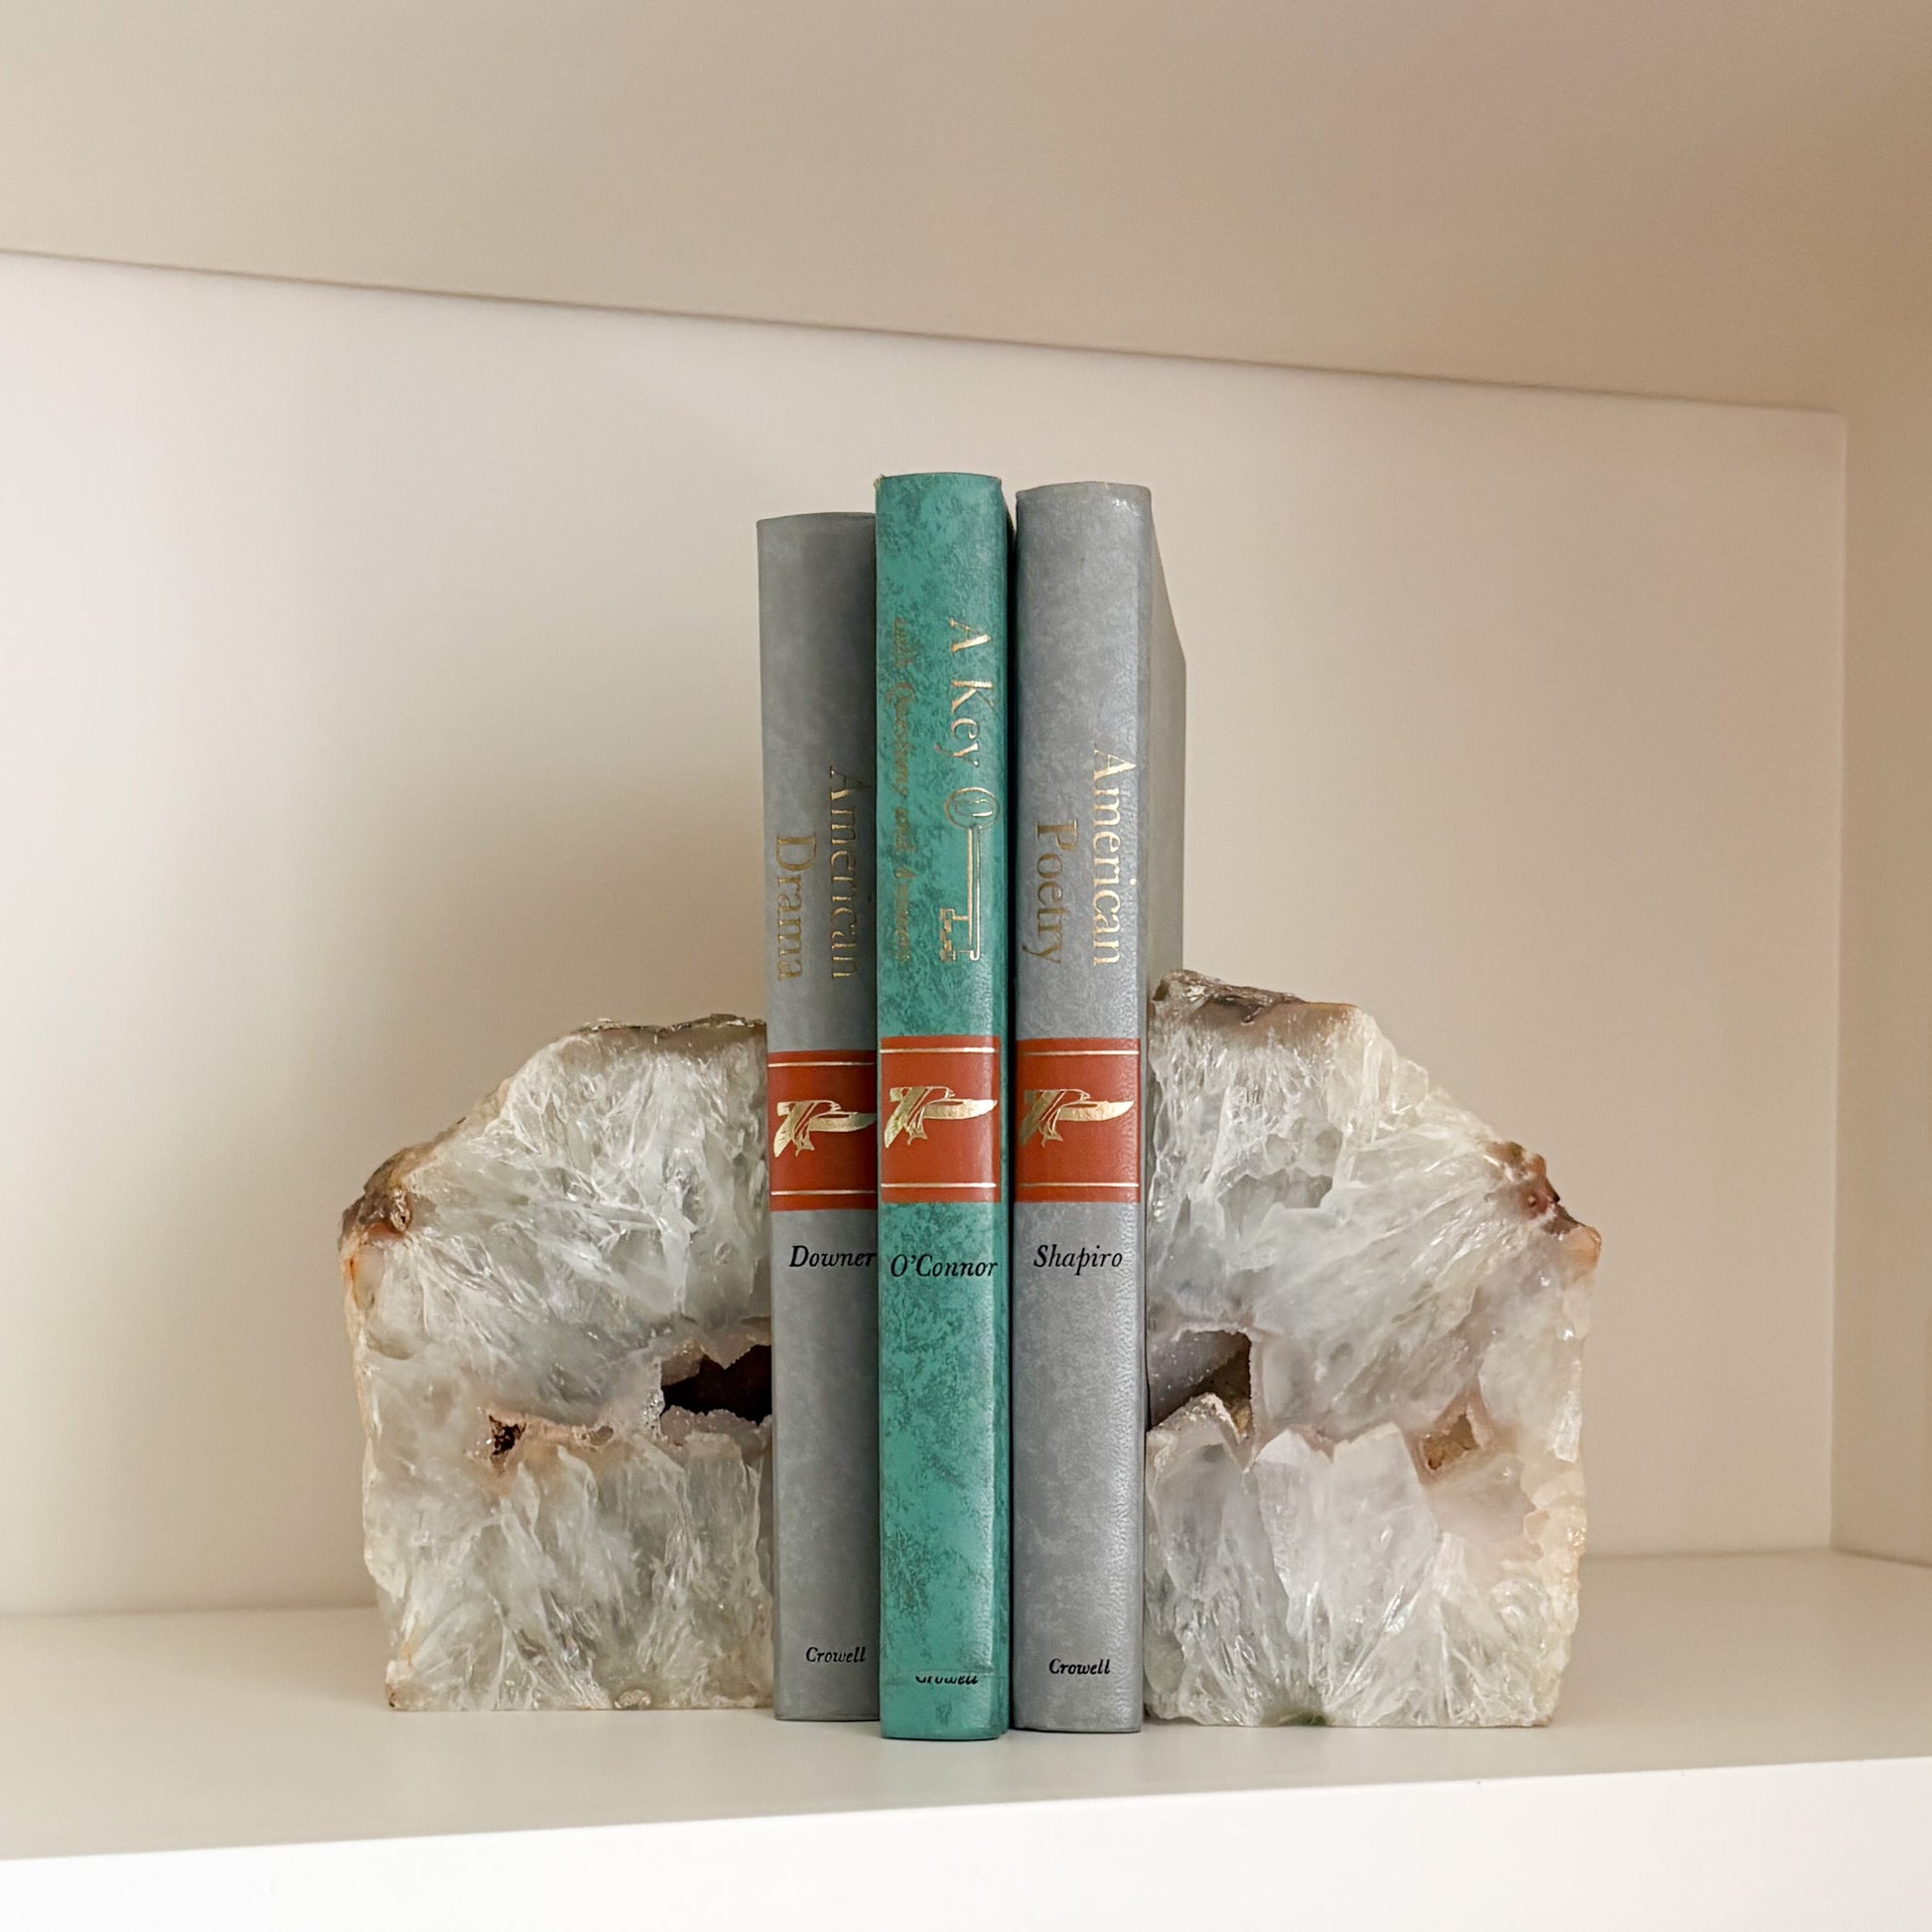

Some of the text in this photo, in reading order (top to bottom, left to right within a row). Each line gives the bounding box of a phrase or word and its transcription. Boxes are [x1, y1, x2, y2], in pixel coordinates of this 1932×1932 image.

[934, 617, 994, 768] A Key
[830, 765, 872, 979] American
[1022, 819, 1079, 965] Poetry
[1092, 744, 1137, 966] American
[776, 833, 817, 981] Drama
[789, 1244, 878, 1268] Downer
[891, 1253, 999, 1278] O'Connor
[1034, 1244, 1124, 1277] Shapiro
[805, 1646, 867, 1664] Crowell
[1048, 1658, 1112, 1676] Crowell
